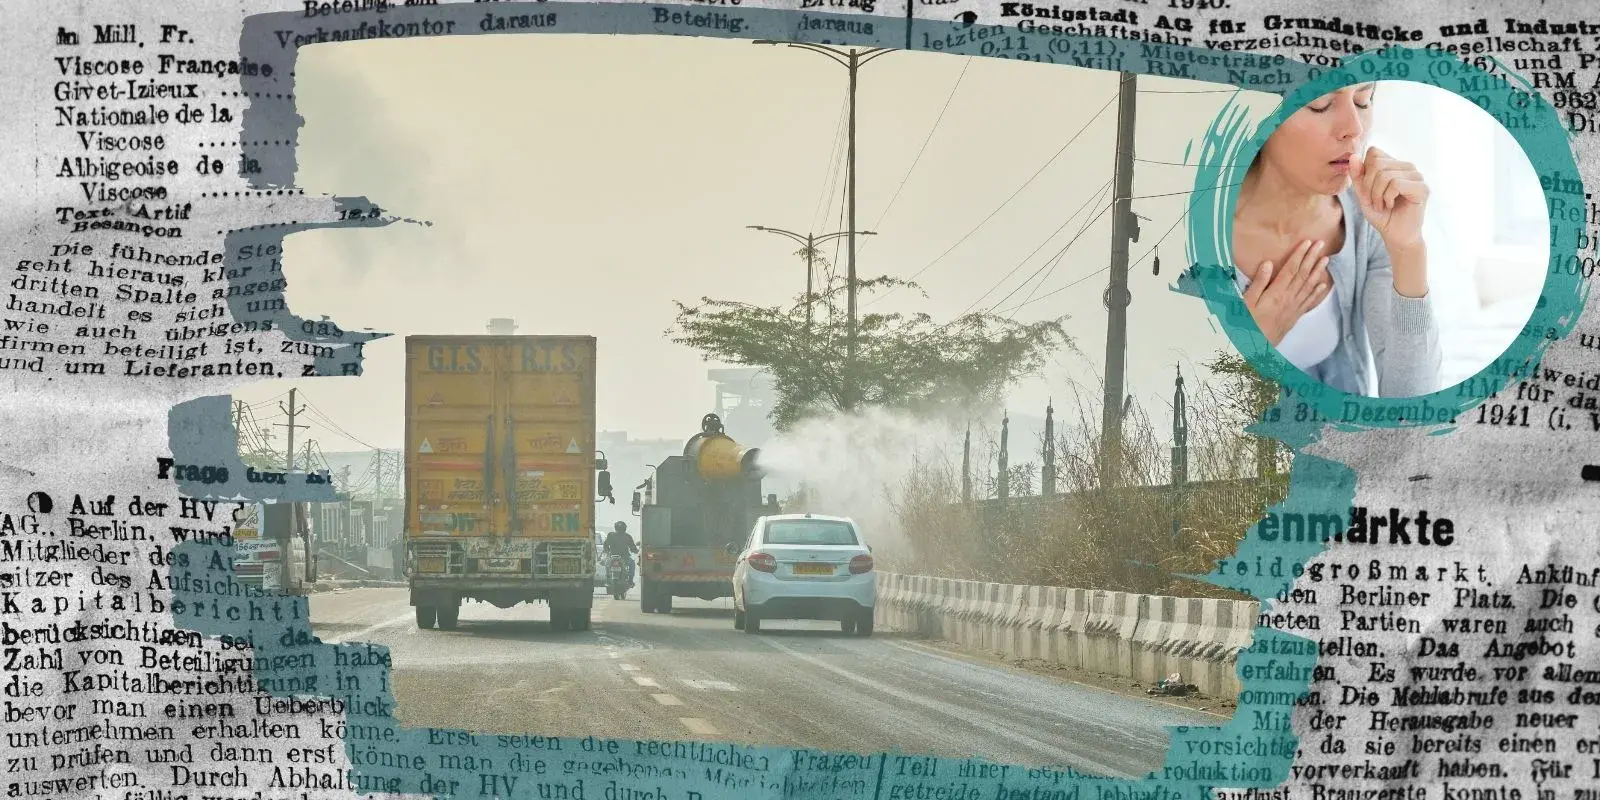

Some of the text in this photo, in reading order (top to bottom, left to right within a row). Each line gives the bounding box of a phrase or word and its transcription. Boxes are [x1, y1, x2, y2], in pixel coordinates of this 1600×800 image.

[480, 11, 557, 31] daraus
[653, 7, 749, 33] Beteilig.
[1001, 2, 1489, 41] Königstadt AG für Grundstücke und
[94, 25, 144, 48] Mill.
[160, 25, 194, 43] Fr.
[923, 19, 1582, 60] letzten Geschäftsjahr verzeichnete die Gesellschaft
[55, 55, 273, 78] Viscose Française
[981, 36, 1029, 56] 0,11
[1048, 37, 1125, 58] (0,11),
[1140, 44, 1285, 69] Mieterträge
[1301, 52, 1343, 68] von
[1361, 58, 1410, 78] 0,49
[1514, 55, 1562, 70] und
[1146, 59, 1197, 79] RM.
[1227, 69, 1292, 85] Nach
[1532, 72, 1576, 89] RM
[54, 79, 199, 101] Givet-Izieux
[55, 104, 233, 127] Nationale de la
[77, 131, 165, 150] Viscose
[56, 154, 261, 180] Albigeoise de la
[81, 182, 168, 201] Viscose
[71, 220, 182, 240] Besançon
[50, 241, 223, 266] Die führende
[16, 258, 72, 274] geht
[202, 266, 253, 284] klar
[11, 274, 206, 304] dritten Spalte
[6, 294, 106, 319] handelt
[128, 309, 152, 323] es
[176, 304, 226, 323] sich
[4, 318, 50, 335] wie
[76, 325, 137, 340] auch
[165, 318, 273, 342] übrigens
[0, 336, 334, 361] firmen beteiligt ist, zum
[0, 357, 105, 375] und um
[1518, 382, 1554, 403] für
[1341, 401, 1530, 427] Dezember 1941
[156, 457, 230, 484] Frage
[70, 494, 219, 521] Auf der HV
[68, 516, 155, 542] Berlin,
[1, 541, 190, 569] Mitglieder des
[0, 566, 131, 589] sitzer des
[1277, 583, 1317, 604] den
[1340, 584, 1430, 607] Berliner
[1455, 587, 1516, 609] Platz.
[1539, 586, 1577, 609] Die
[1340, 609, 1574, 634] Partien waren auch
[1, 621, 202, 649] berücksichtigen
[1418, 636, 1576, 660] Das Angebot
[3, 646, 315, 674] Zahl von Beteiligungen
[1242, 660, 1600, 684] erfahren. Es wurde vor allem
[4, 671, 361, 698] die Kapitalberichtigung in
[1339, 686, 1556, 706] Die Mehlabrufe aus
[5, 696, 391, 723] bevor man einen Ueberblick
[1252, 710, 1579, 733] Mit der Herausgabe neuer
[7, 721, 175, 749] unternehmen
[191, 718, 301, 740] erhalten
[320, 718, 400, 743] könne.
[498, 735, 562, 750] seien
[581, 735, 619, 753] die
[1185, 733, 1557, 759] vorsichtig, da sie bereits einen
[7, 742, 546, 773] zu prüfen und dann erst könne man die
[896, 756, 938, 777] Teil
[958, 759, 1010, 779] ihrer
[1292, 759, 1420, 781] vorverkauft
[1438, 758, 1508, 779] haben.
[1531, 758, 1573, 785] Für
[7, 772, 146, 797] auswerten.
[171, 765, 248, 788] Durch
[270, 765, 401, 793] Abhaltung
[420, 774, 460, 796] der
[479, 774, 519, 797] HV
[538, 780, 584, 800] und
[890, 783, 980, 800] getreide
[996, 783, 1079, 800] bestand
[1096, 785, 1182, 800] lebhafte
